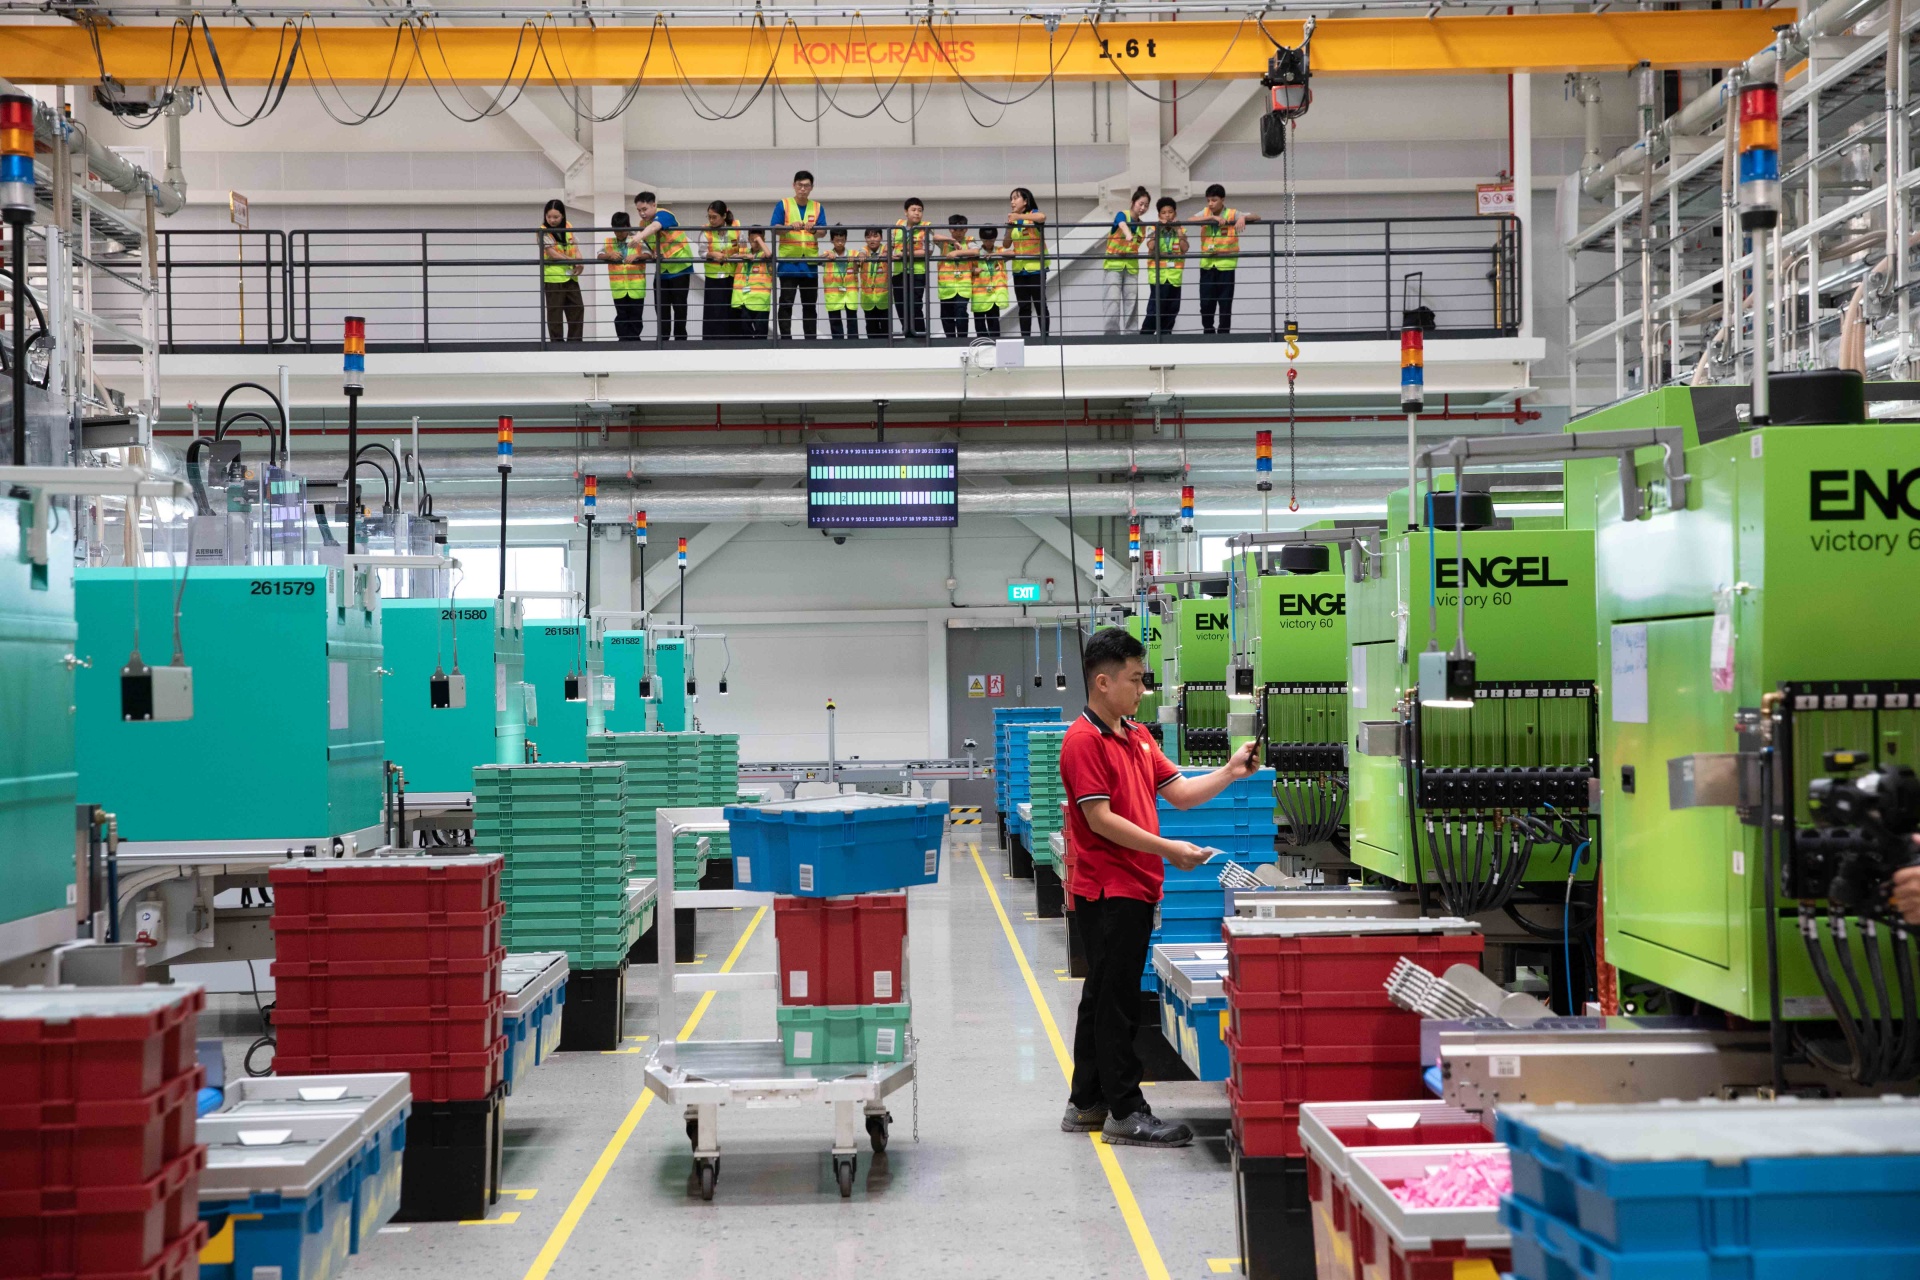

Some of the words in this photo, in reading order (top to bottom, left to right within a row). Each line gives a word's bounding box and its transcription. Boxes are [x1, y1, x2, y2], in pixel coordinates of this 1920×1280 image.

[793, 40, 975, 64] KONECRANES
[1098, 38, 1140, 59] 1.6
[1146, 38, 1157, 58] t
[1810, 529, 1899, 556] victory
[1436, 556, 1568, 588] ENGEL
[250, 581, 315, 596] 261579
[1013, 587, 1034, 599] EXIT
[1279, 593, 1346, 616] ENGE
[1436, 593, 1488, 609] vicory
[1493, 592, 1512, 605] 60
[441, 610, 487, 620] 261580
[545, 627, 580, 636] 261581
[1280, 619, 1317, 630] victory
[1320, 618, 1334, 628] 60
[611, 637, 640, 645] 261582
[1196, 633, 1224, 642] victory
